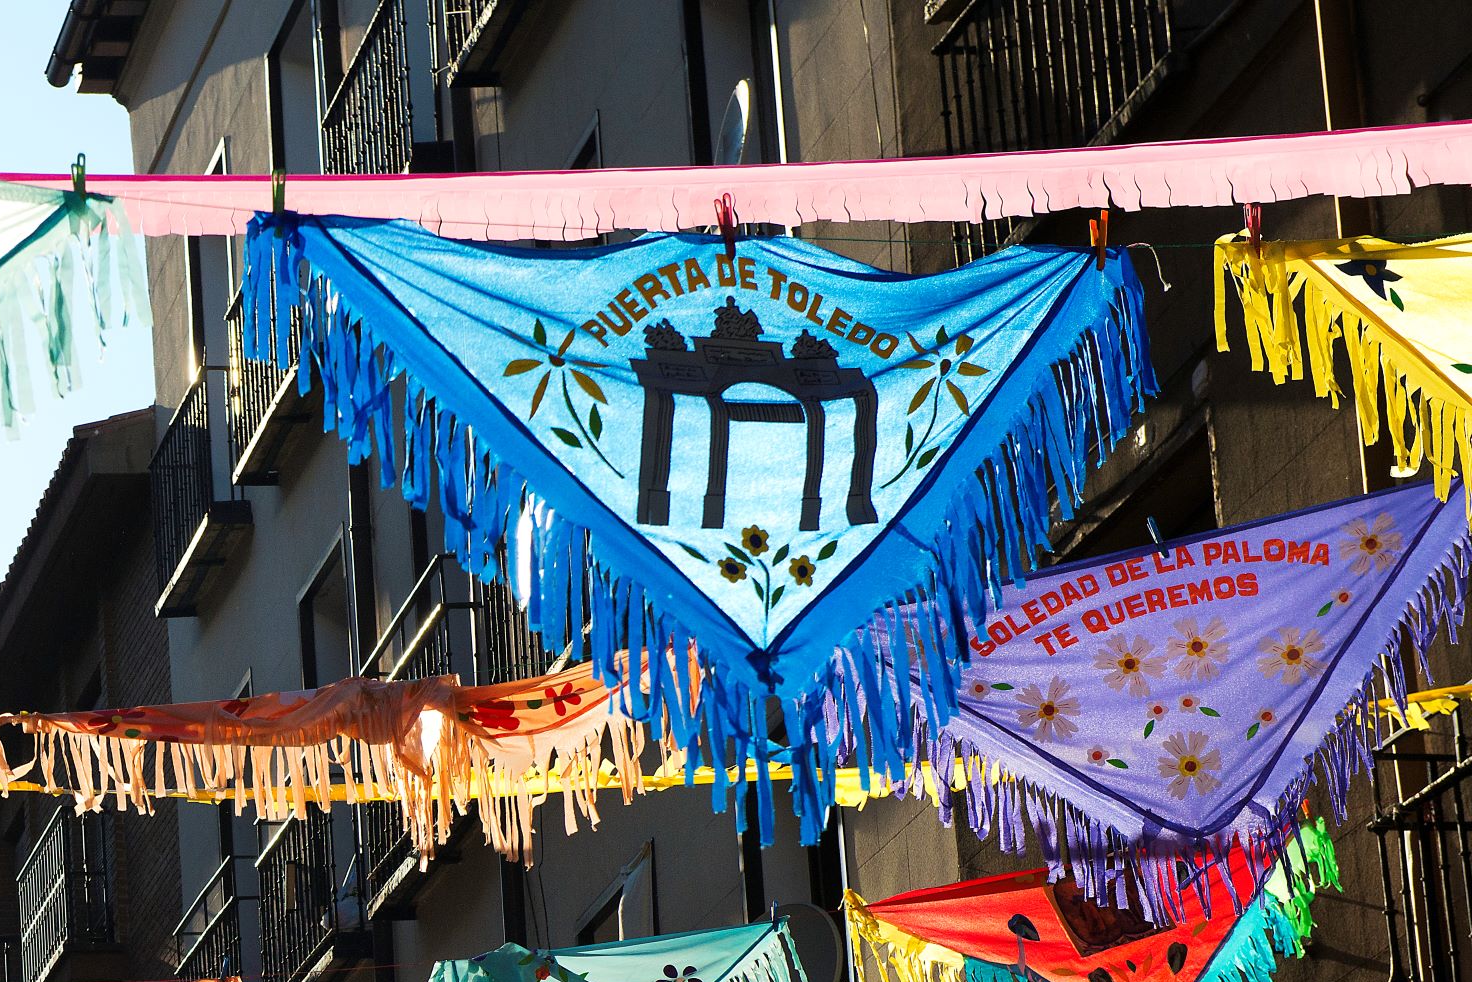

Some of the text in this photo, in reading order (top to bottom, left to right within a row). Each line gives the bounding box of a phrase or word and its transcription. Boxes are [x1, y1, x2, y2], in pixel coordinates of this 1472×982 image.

[580, 253, 900, 359] PUERTA DE TOLEDO
[970, 539, 1329, 657] SOLEDAD DE LA PALOMA
[1034, 573, 1259, 657] TE QUEREMOS
